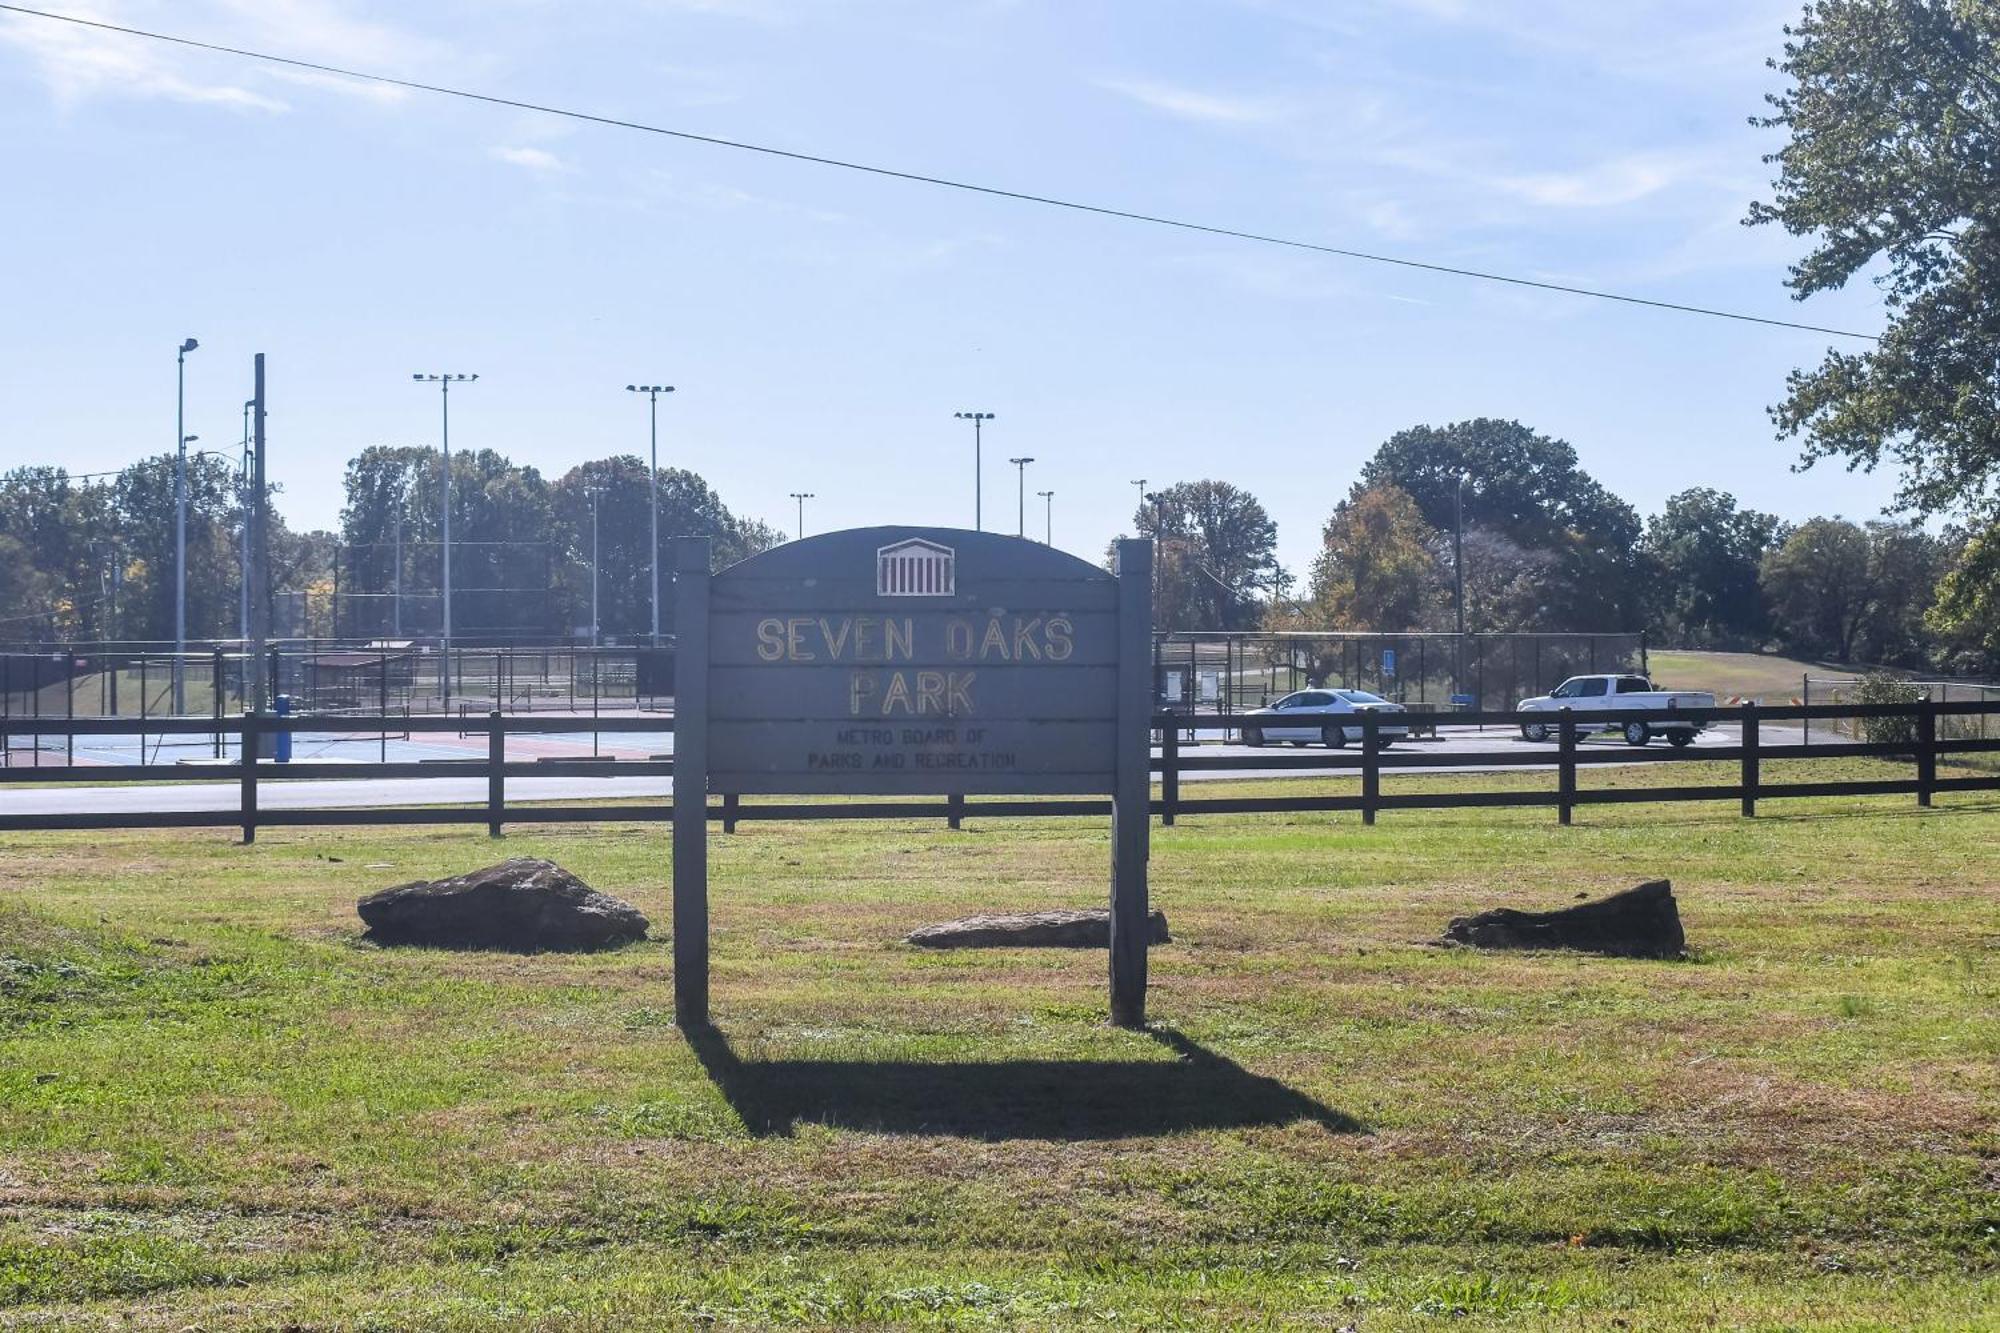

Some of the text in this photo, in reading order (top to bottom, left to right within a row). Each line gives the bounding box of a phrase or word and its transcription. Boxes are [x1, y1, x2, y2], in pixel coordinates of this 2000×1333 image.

[757, 618, 1073, 660] SEVEN OAKS
[850, 672, 976, 715] PARK
[837, 729, 987, 745] METRO BOARD OF
[807, 753, 1016, 769] PARKS AND RECREATION
